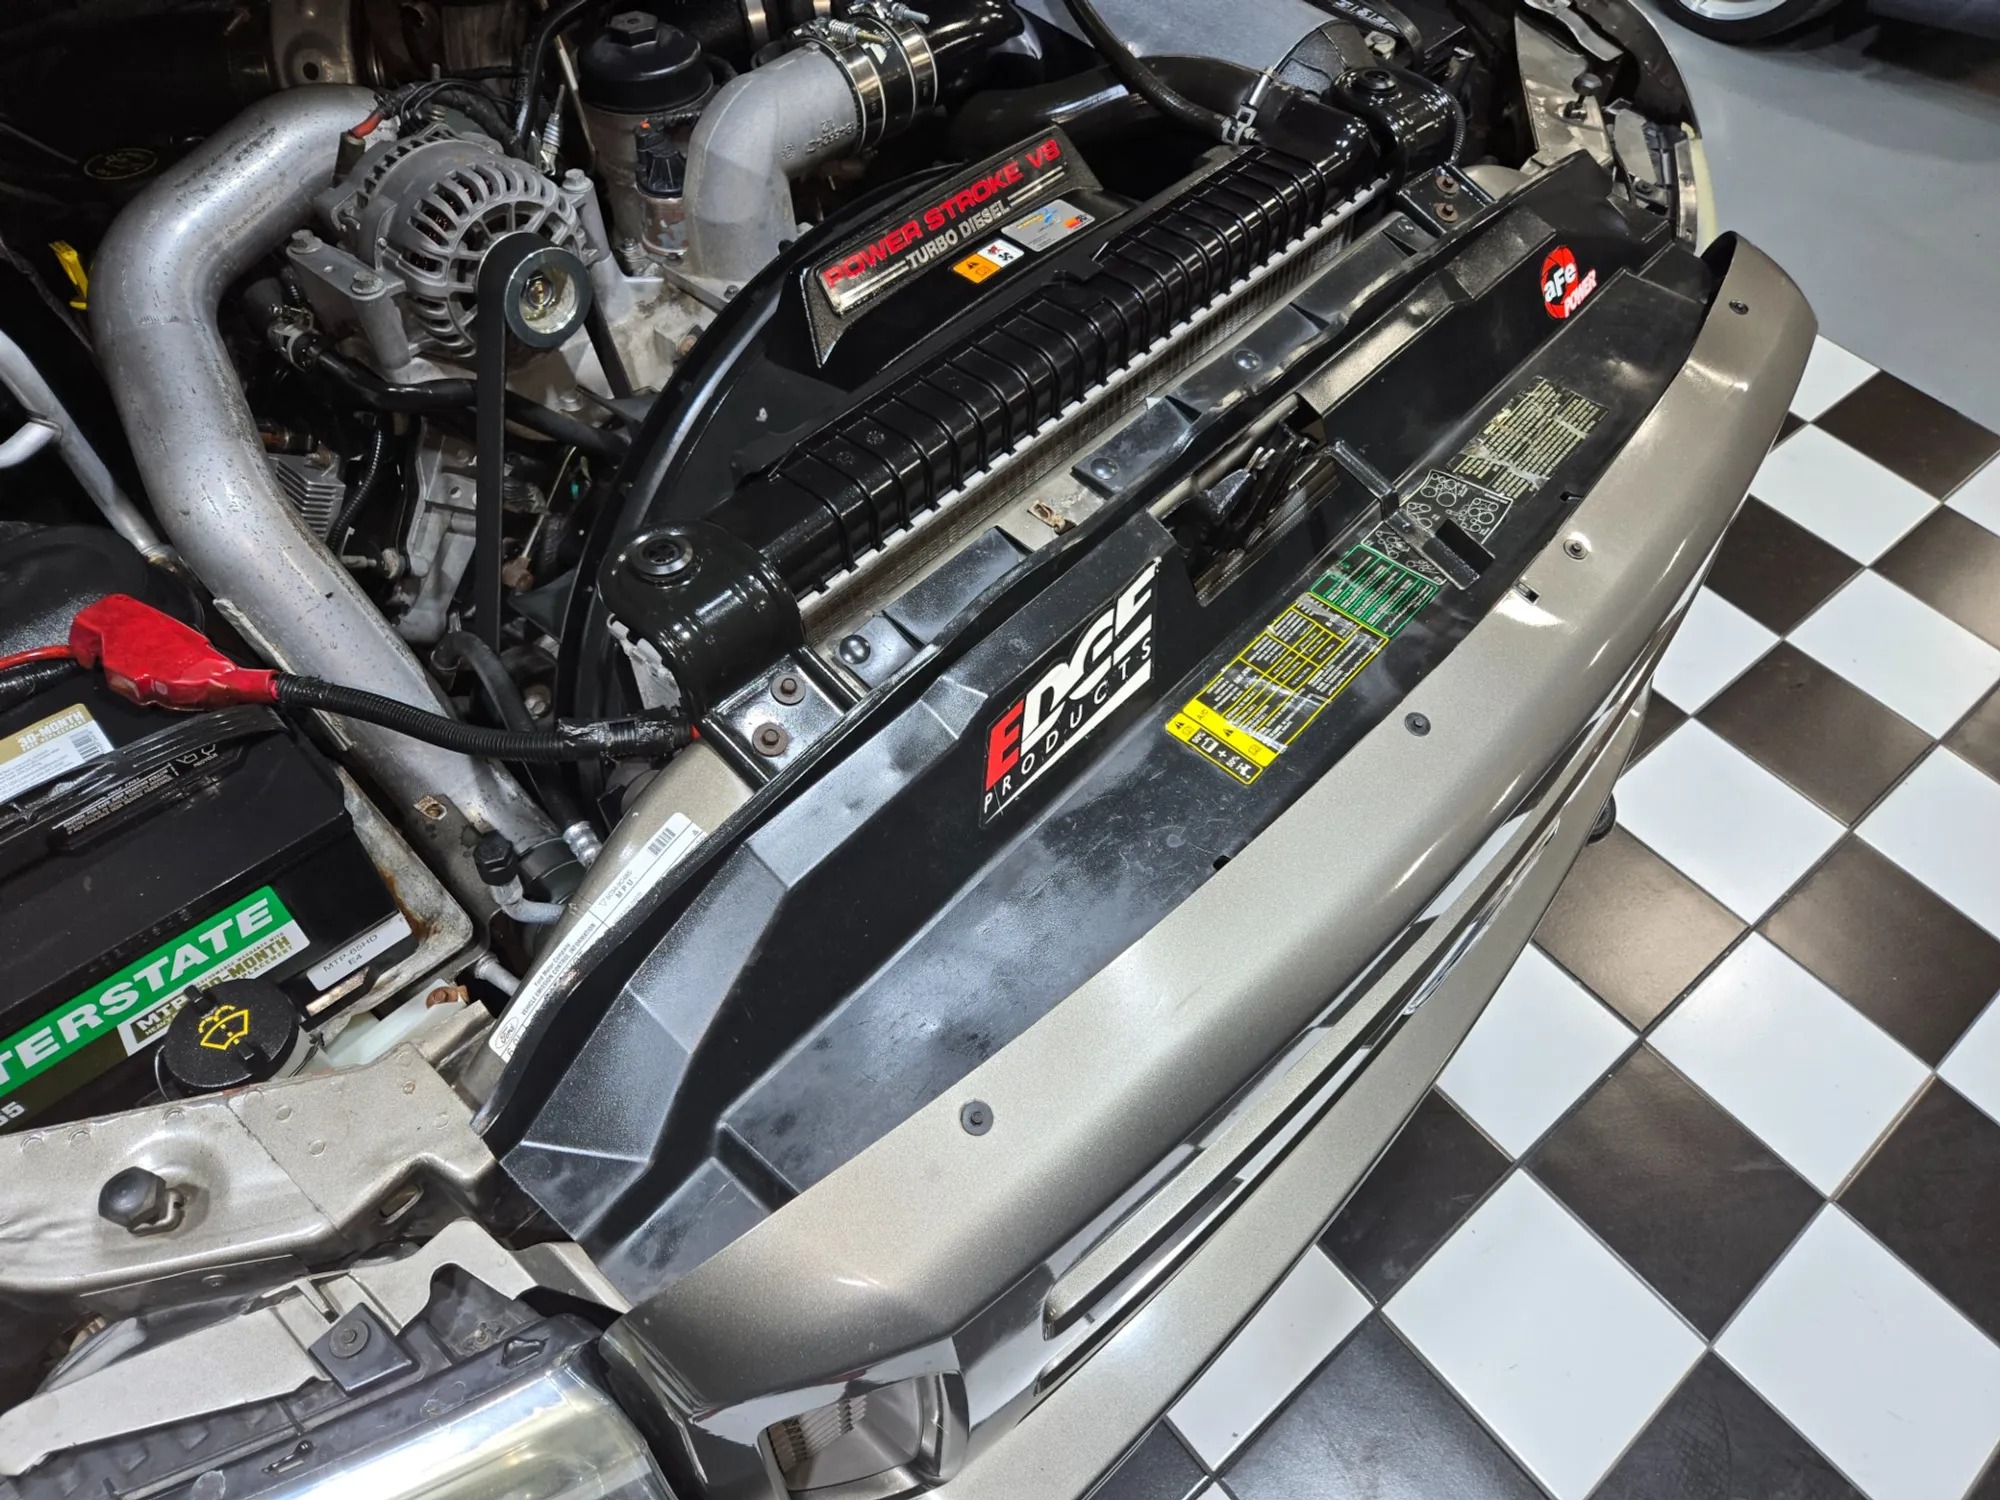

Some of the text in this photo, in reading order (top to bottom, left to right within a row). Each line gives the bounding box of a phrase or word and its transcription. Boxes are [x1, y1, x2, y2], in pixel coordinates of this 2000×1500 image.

[821, 218, 924, 289] POWER
[924, 160, 1024, 231] STROKE
[1025, 138, 1062, 169] V8
[905, 229, 959, 269] TURBO
[960, 199, 1012, 239] DIESEL
[1543, 262, 1577, 302] aFe
[1564, 268, 1598, 318] POWER
[985, 559, 1158, 791] EDGE
[17, 710, 85, 747] 30-MONTH
[984, 637, 1151, 813] PRODUCTS
[521, 923, 596, 1015] VEHICLE EMISSION CONTROL INFORMATION
